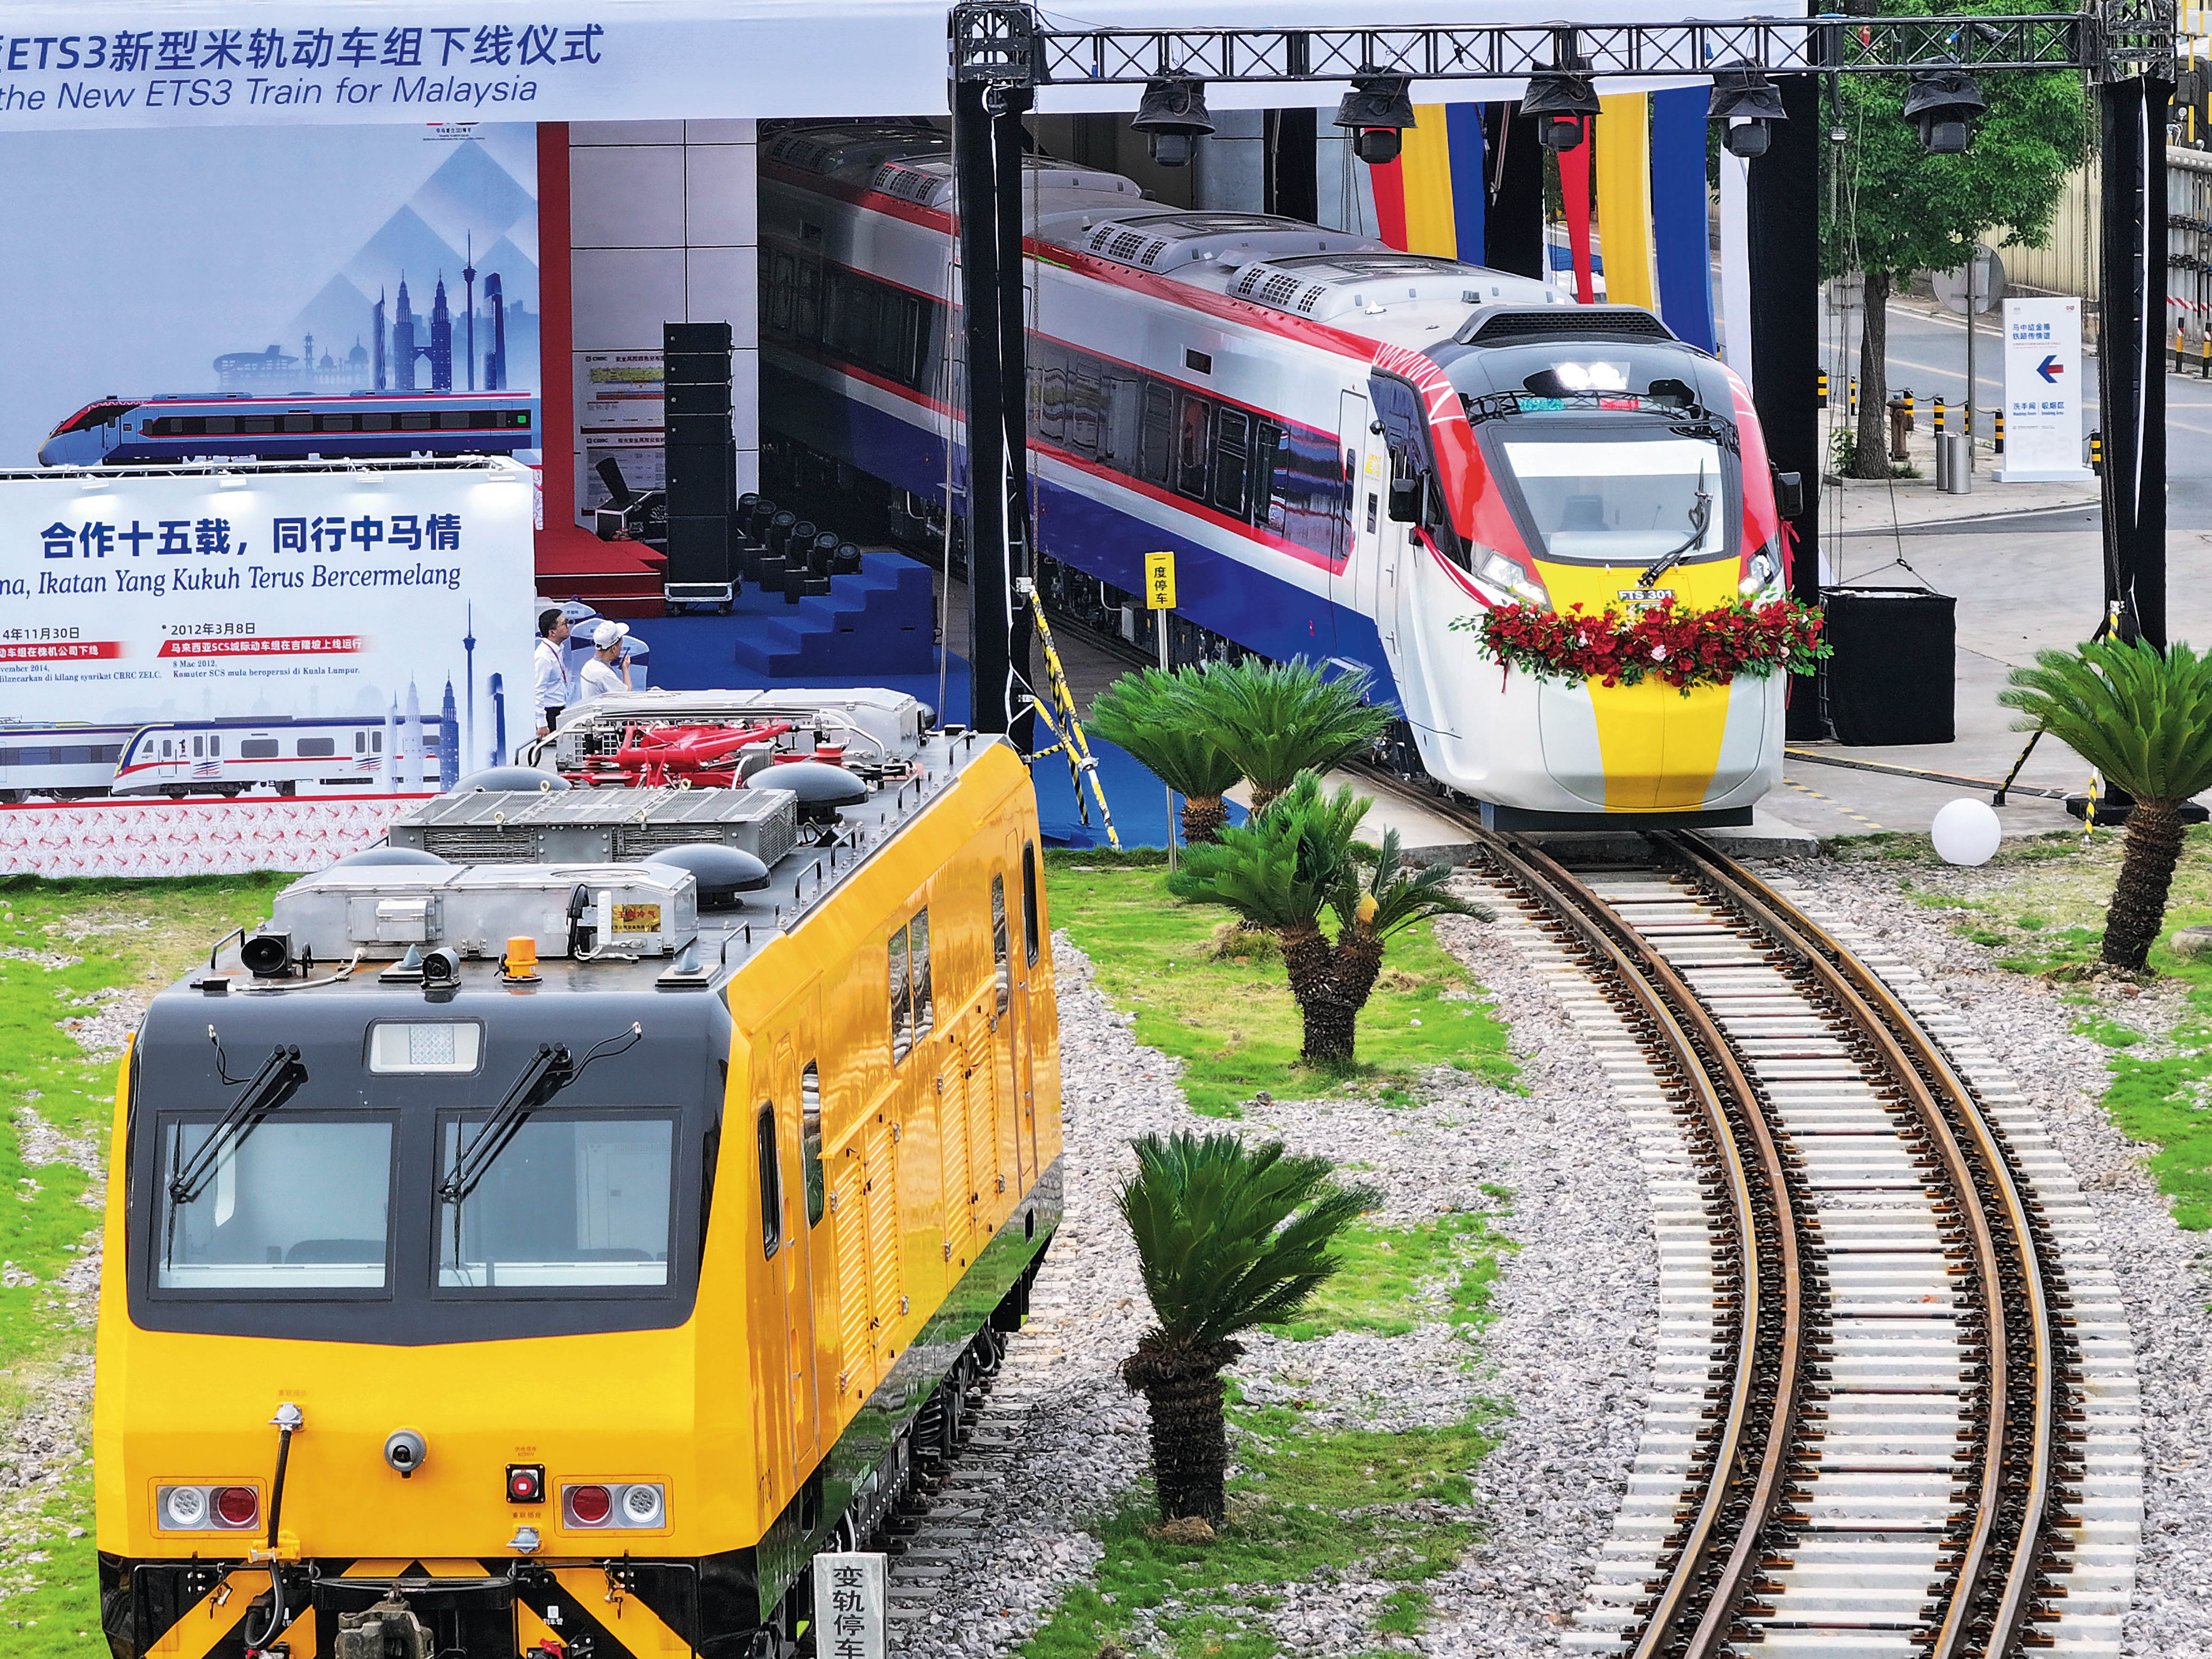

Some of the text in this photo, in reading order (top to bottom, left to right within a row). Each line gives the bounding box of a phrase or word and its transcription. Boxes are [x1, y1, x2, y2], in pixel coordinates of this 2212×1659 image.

[0, 24, 604, 73] ETS3新型米轨动车组下线仪式
[57, 81, 136, 109] New
[145, 79, 233, 106] ETS3
[246, 78, 322, 105] Train
[336, 76, 383, 104] for
[393, 74, 538, 108] Malaysia
[38, 571, 107, 594] Ikatan
[115, 569, 166, 597] Yang
[172, 567, 240, 591] Kukuh
[248, 566, 305, 589] Terus
[311, 563, 461, 590] Bercermelang
[1153, 558, 1168, 604] 一度停车
[1648, 590, 1672, 600] 301
[171, 623, 255, 635] 2012年3月8日
[180, 660, 196, 668] Mac
[209, 669, 225, 677] SCS
[227, 668, 247, 677] mula
[249, 667, 290, 677] beroperasi
[293, 667, 301, 675] di
[303, 667, 326, 675] Kuala
[55, 673, 79, 682] kilang
[80, 672, 112, 682] syarikat
[833, 1565, 865, 1659] 变轨停车
